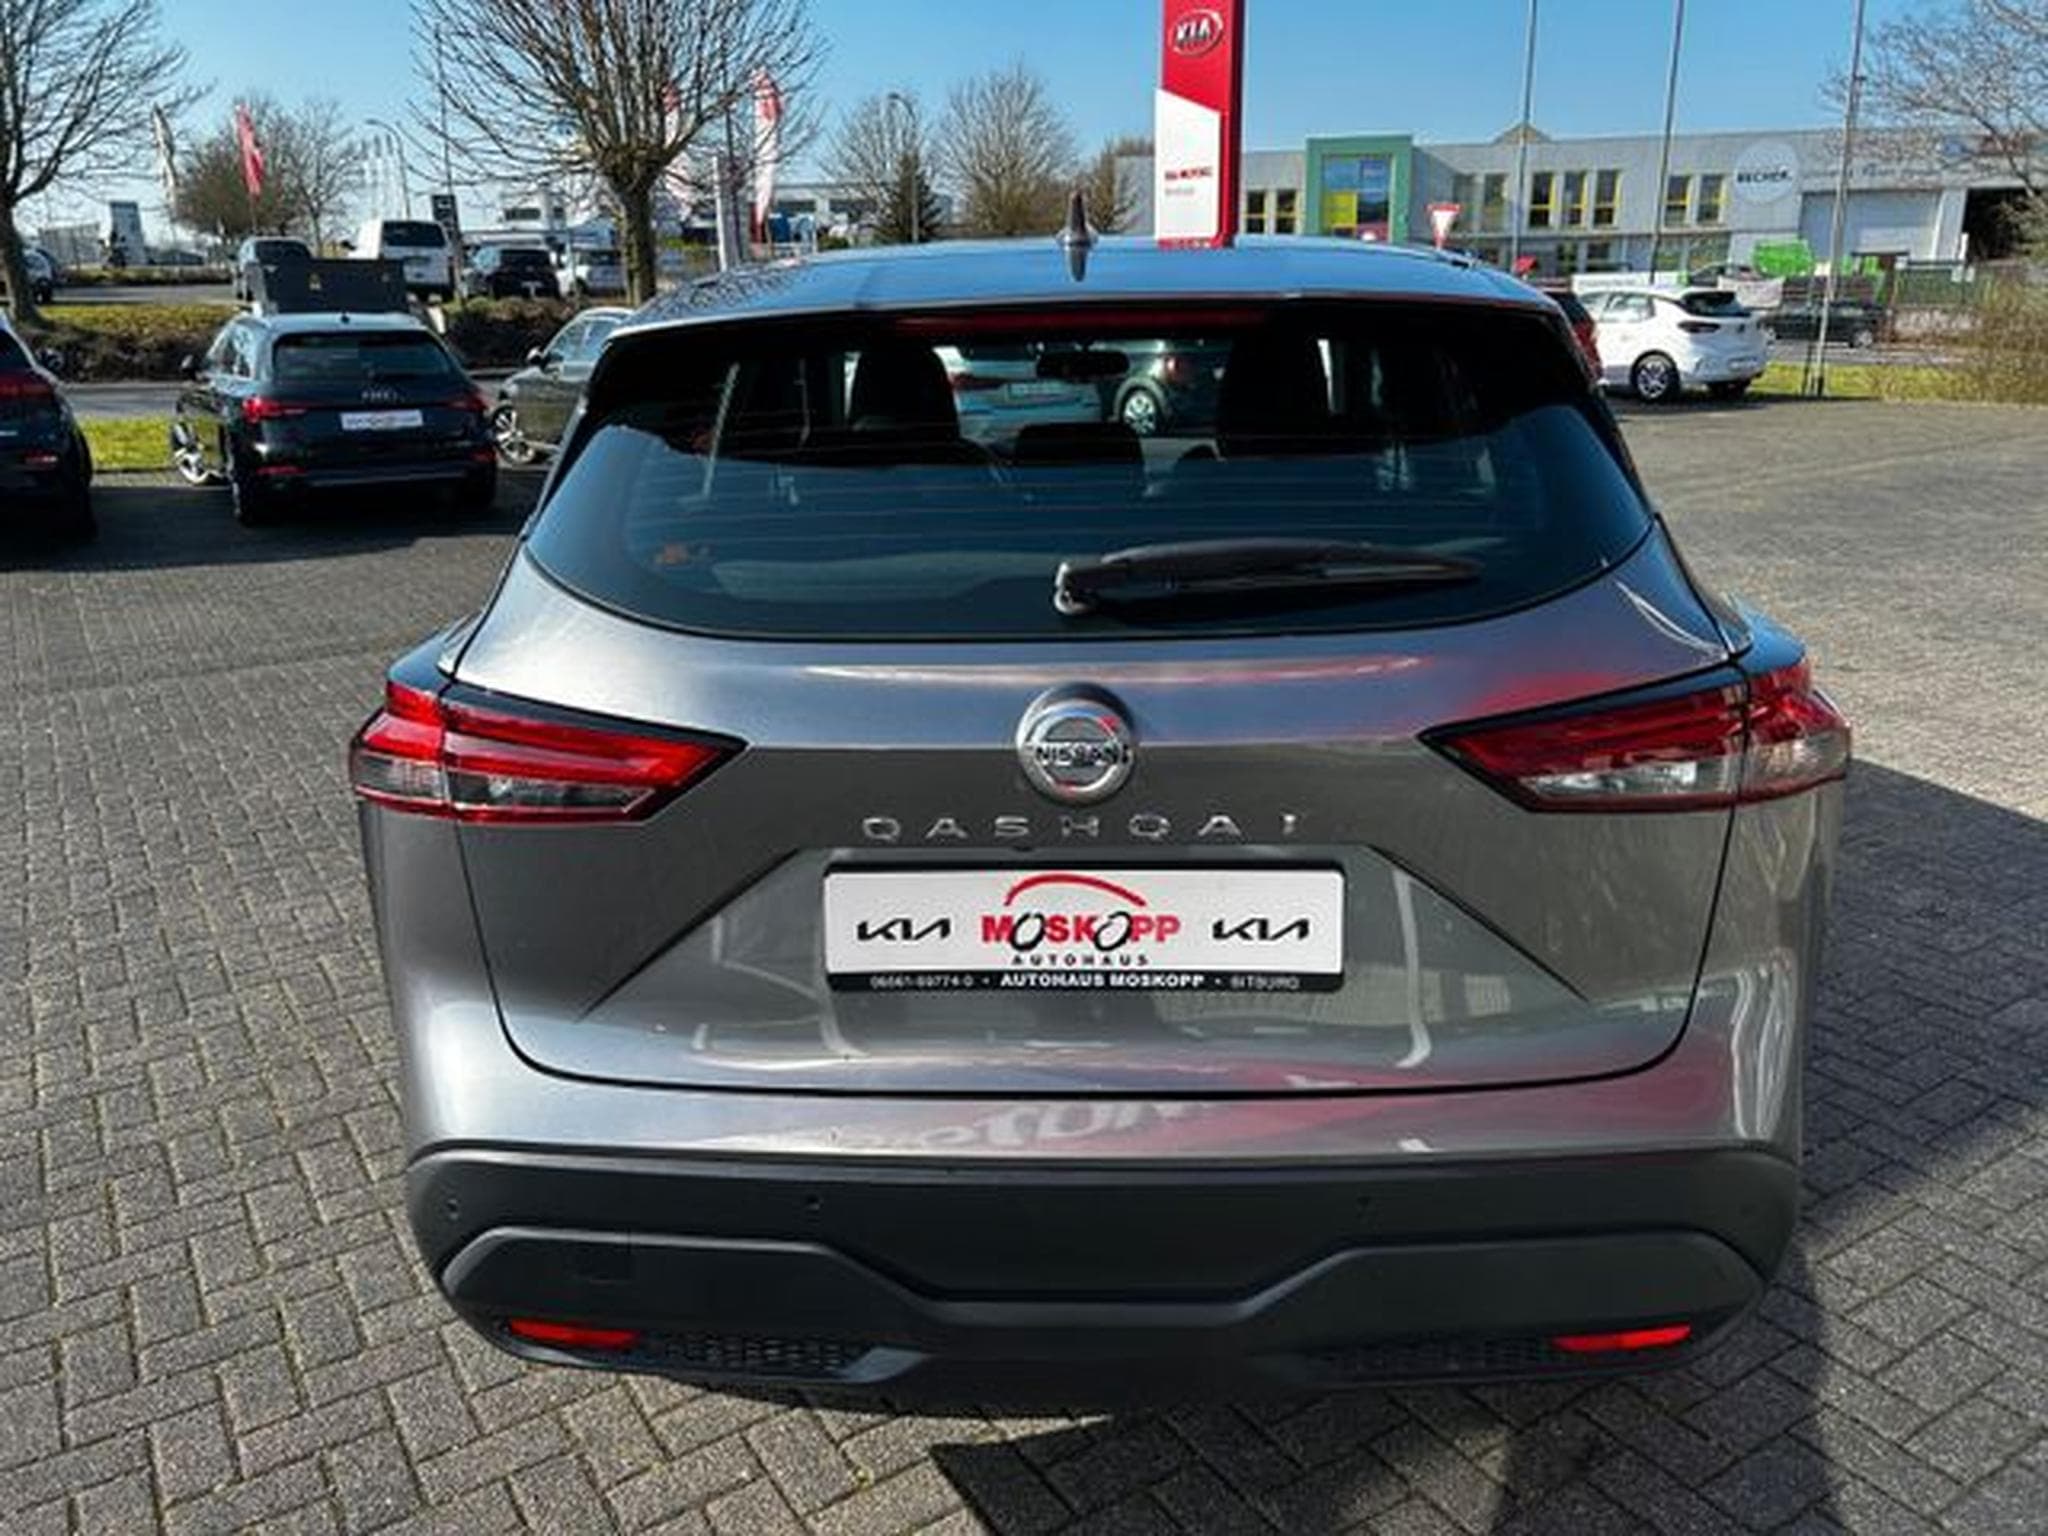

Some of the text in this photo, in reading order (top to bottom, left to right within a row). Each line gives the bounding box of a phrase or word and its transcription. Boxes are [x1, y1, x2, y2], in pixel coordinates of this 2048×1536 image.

[1035, 743, 1129, 766] NISSAN
[862, 813, 1297, 840] QASHQAI
[857, 917, 951, 942] KIA
[981, 911, 1181, 951] MOSKOPP
[1212, 917, 1309, 942] KIA
[1011, 954, 1149, 966] AUTOHAUS
[1001, 973, 1105, 987] AUTOHAUS
[1109, 973, 1205, 987] MOSKOPP
